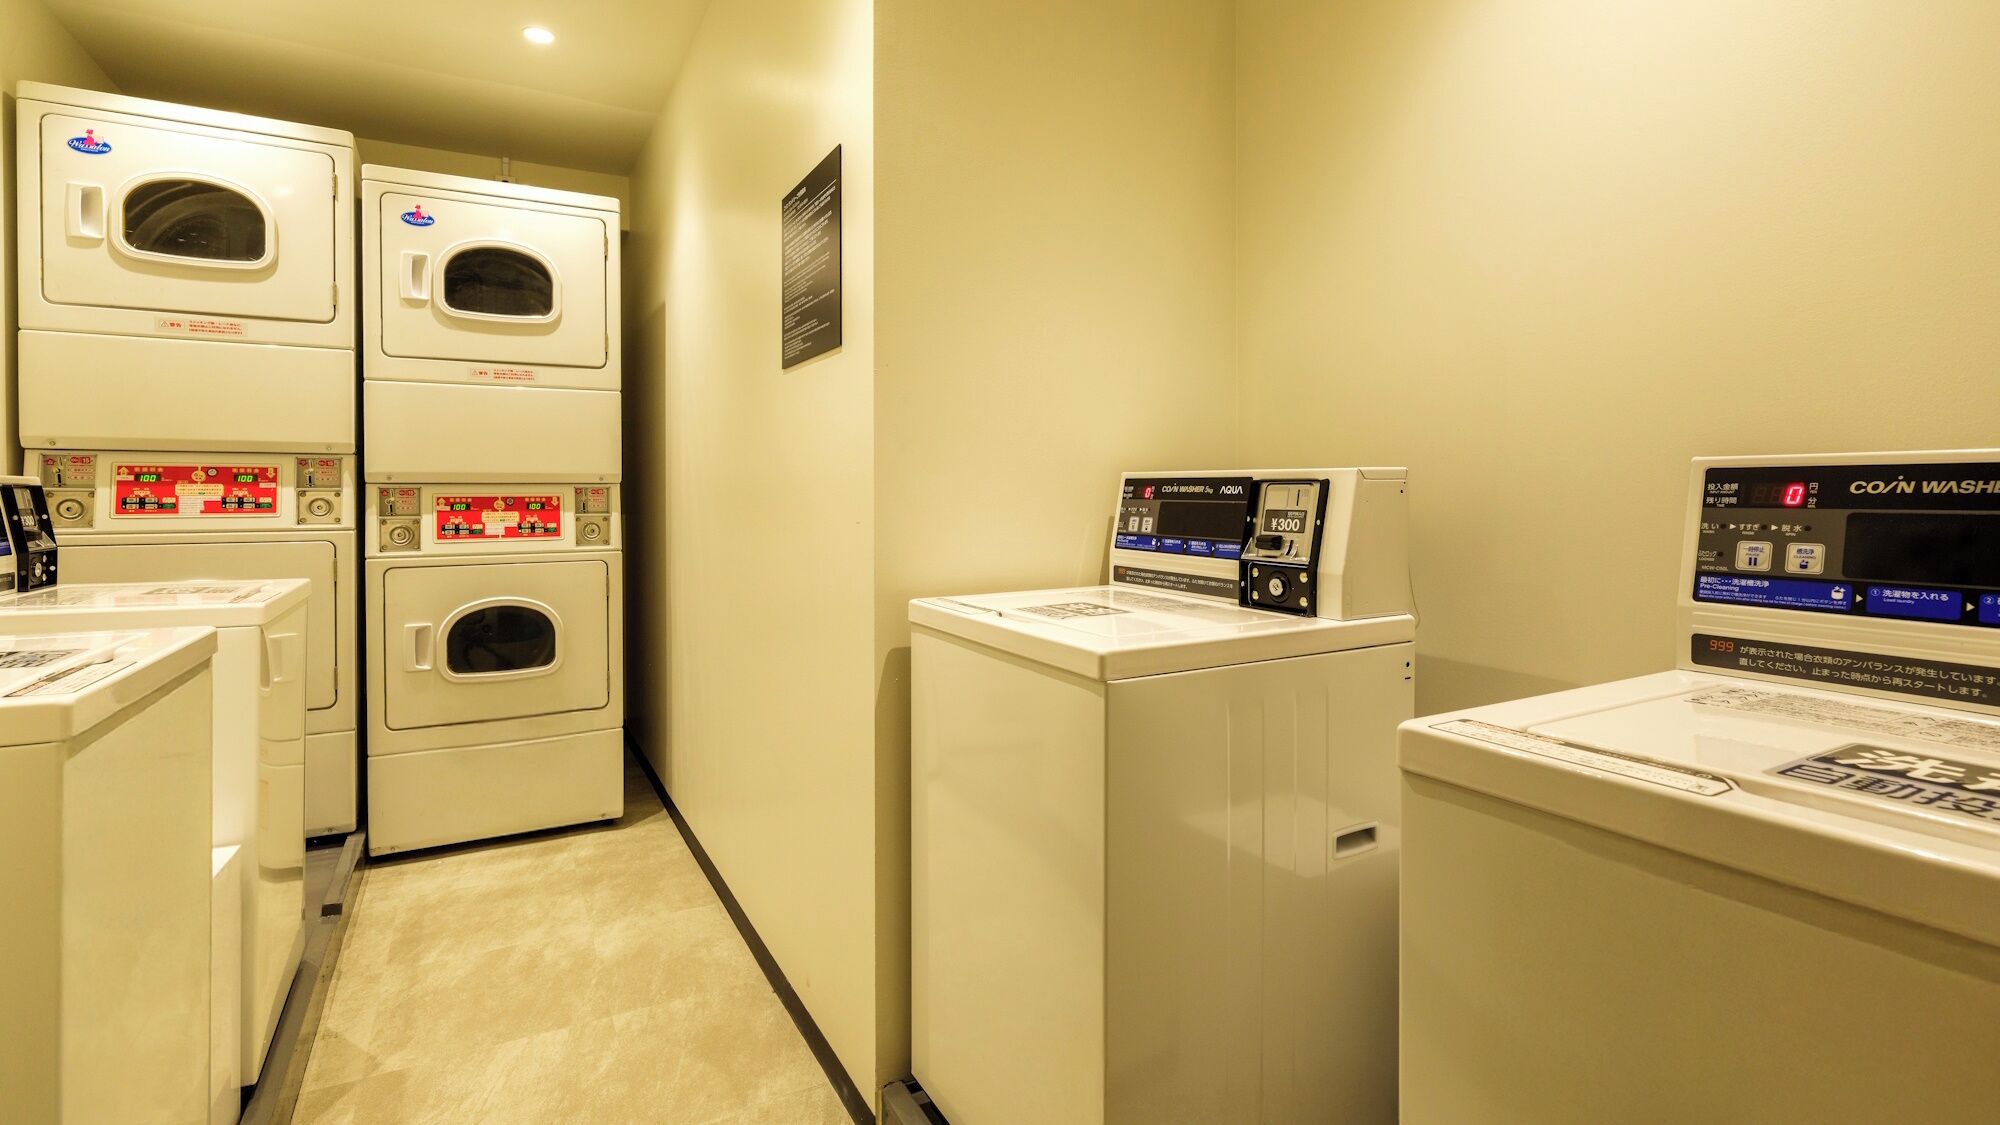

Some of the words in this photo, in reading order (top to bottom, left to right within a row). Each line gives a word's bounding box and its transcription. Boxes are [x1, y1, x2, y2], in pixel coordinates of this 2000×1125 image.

[1162, 483, 1179, 493] COIN
[1220, 485, 1243, 494] AQUA
[1707, 483, 1739, 491] 投入金額
[1809, 482, 1819, 491] 円
[1849, 475, 1916, 494] COIN
[1145, 487, 1151, 498] 0
[1786, 486, 1803, 505] 0
[1706, 496, 1738, 504] 残り時間
[1807, 497, 1818, 505] 分
[1271, 517, 1300, 531] ¥300
[1739, 523, 1760, 531] すすぎ
[1700, 583, 1740, 592] Pre-Cleaning
[1882, 589, 1949, 602] 洗濯物を入れる
[1709, 639, 1734, 653] 999
[1776, 764, 2000, 821] 自動投
